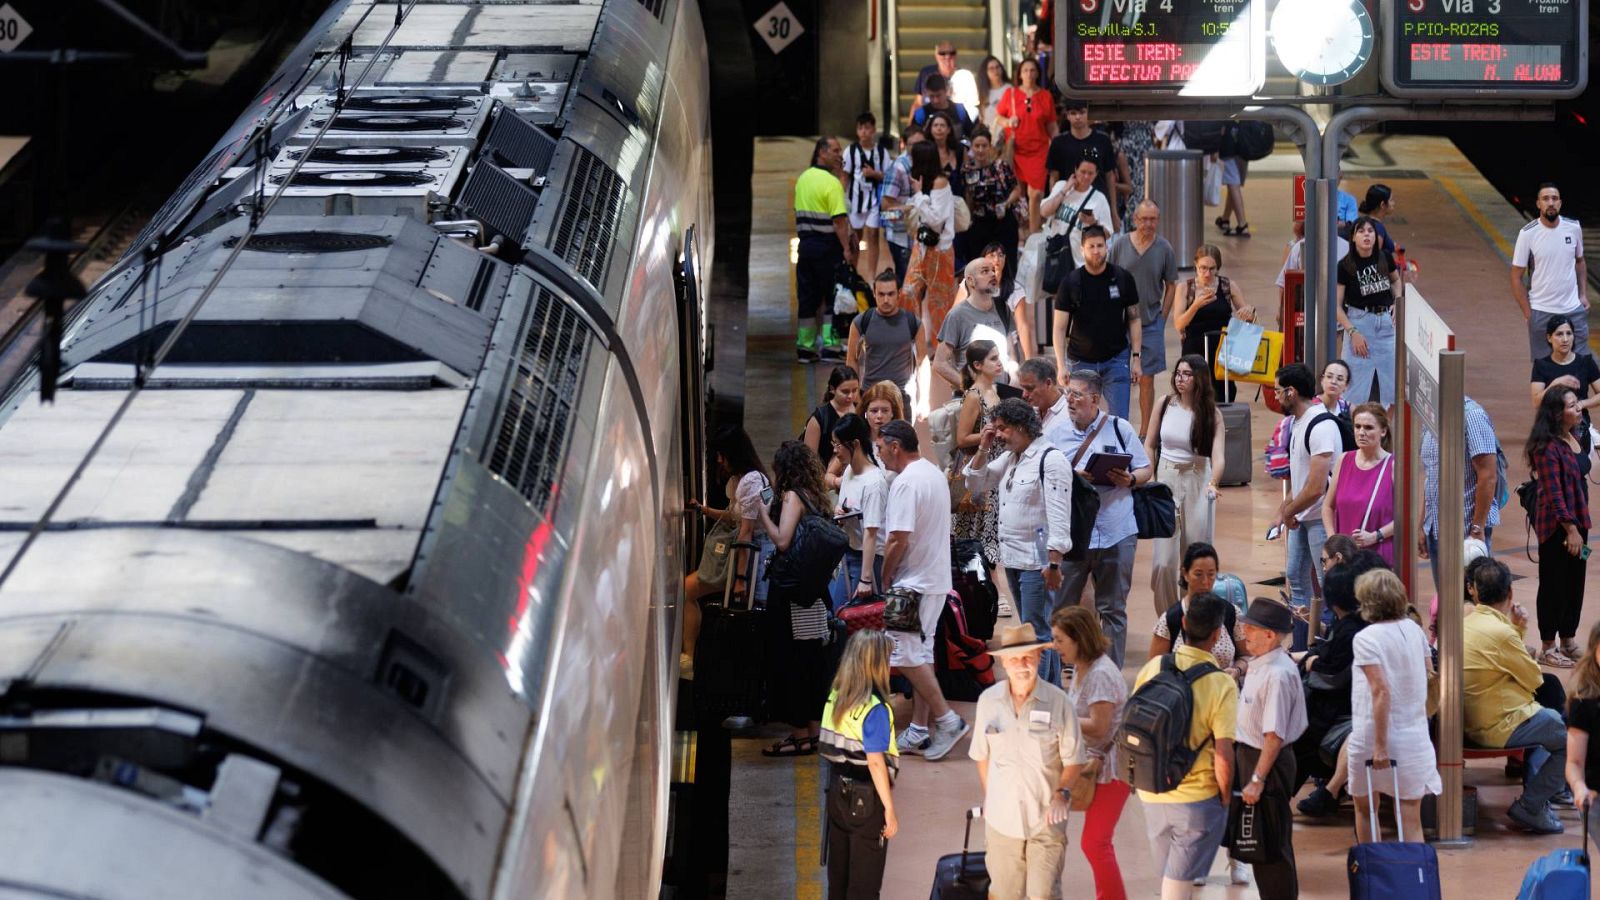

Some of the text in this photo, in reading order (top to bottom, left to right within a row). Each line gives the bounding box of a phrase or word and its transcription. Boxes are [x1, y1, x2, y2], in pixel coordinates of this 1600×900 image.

[1159, 0, 1174, 14] 4
[1213, 4, 1235, 13] tren
[1539, 5, 1560, 14] tren
[768, 16, 790, 39] 30
[1077, 23, 1131, 36] Sevilla
[1201, 22, 1240, 36] 10:5
[1404, 23, 1499, 37] P.PIO-ROZAS
[1084, 44, 1183, 61] ESTE TREN:
[1410, 43, 1508, 61] ESTE TREN:
[1089, 64, 1162, 81] EFECTUA
[1356, 264, 1378, 281] LOV
